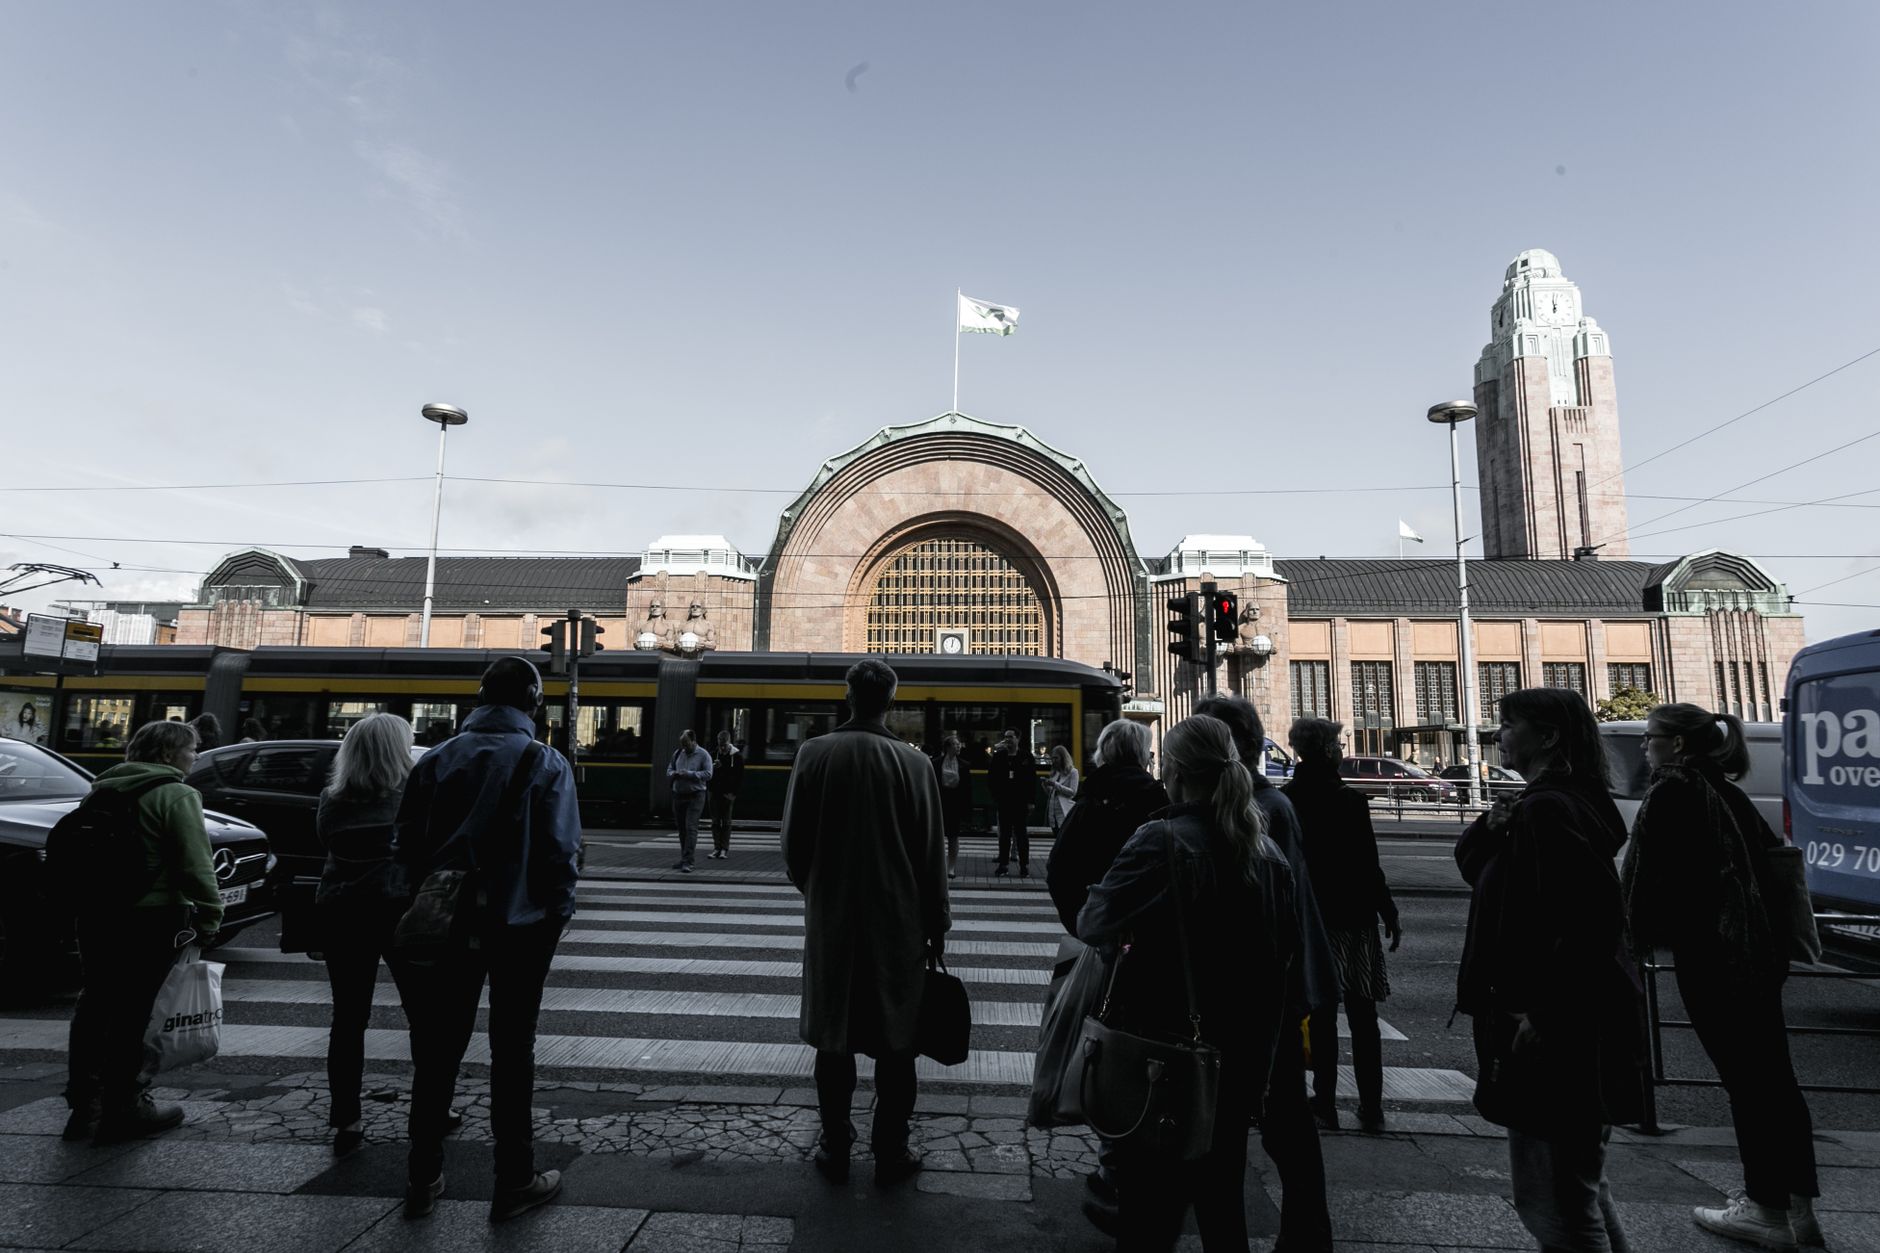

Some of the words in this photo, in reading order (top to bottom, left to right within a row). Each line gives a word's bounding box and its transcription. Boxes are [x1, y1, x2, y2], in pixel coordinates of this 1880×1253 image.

[1801, 709, 1880, 785] pa
[1829, 766, 1880, 787] ove
[1806, 840, 1845, 867] 029
[1853, 845, 1880, 873] 70
